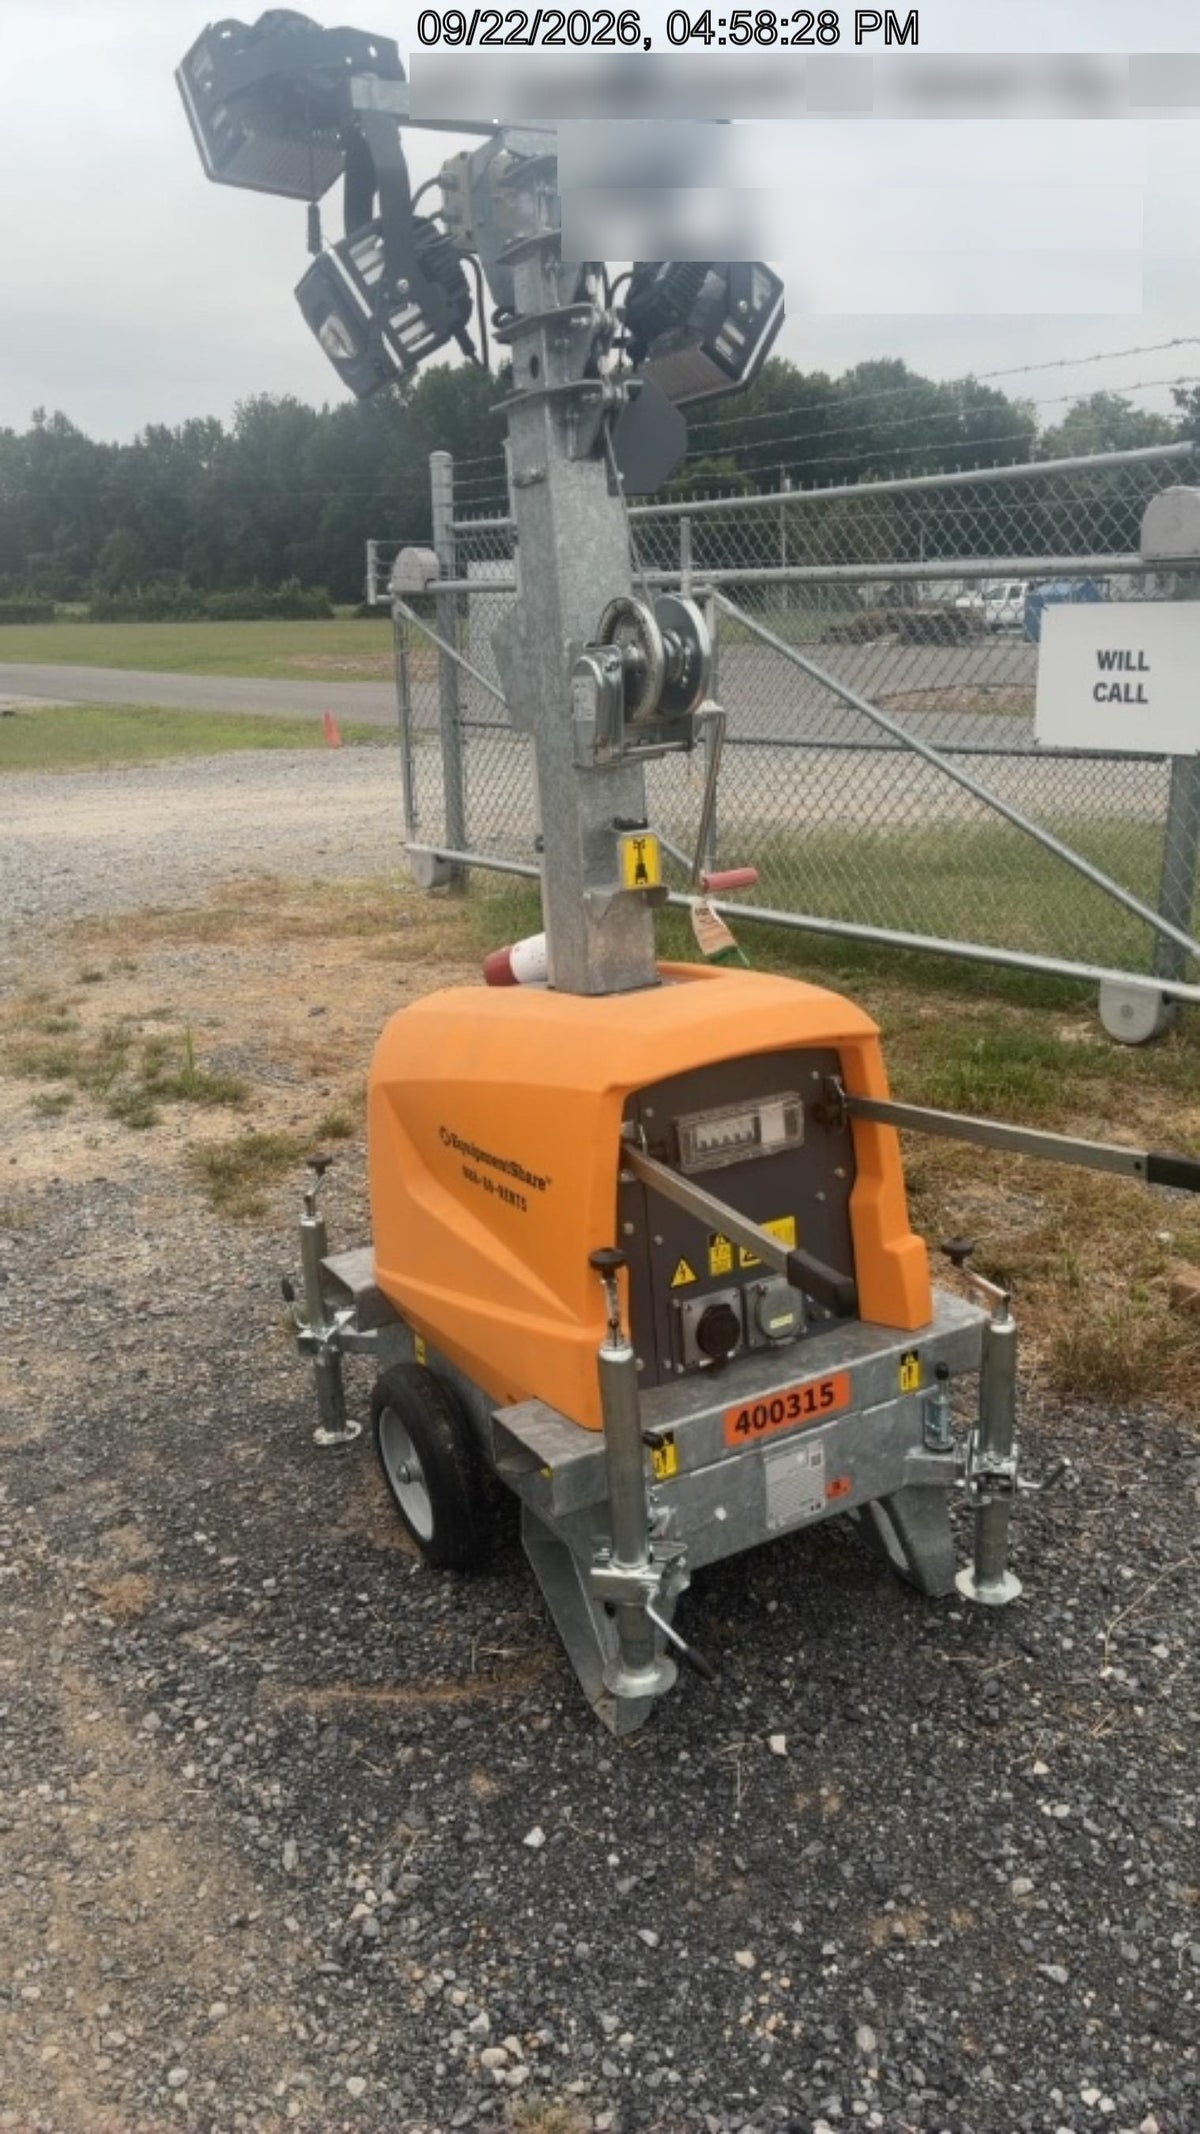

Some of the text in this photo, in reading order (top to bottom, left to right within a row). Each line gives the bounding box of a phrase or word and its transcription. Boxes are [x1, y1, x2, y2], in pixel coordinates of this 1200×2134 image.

[1096, 649, 1150, 672] WILL
[1092, 682, 1149, 705] CALL
[734, 1381, 836, 1436] 400315
